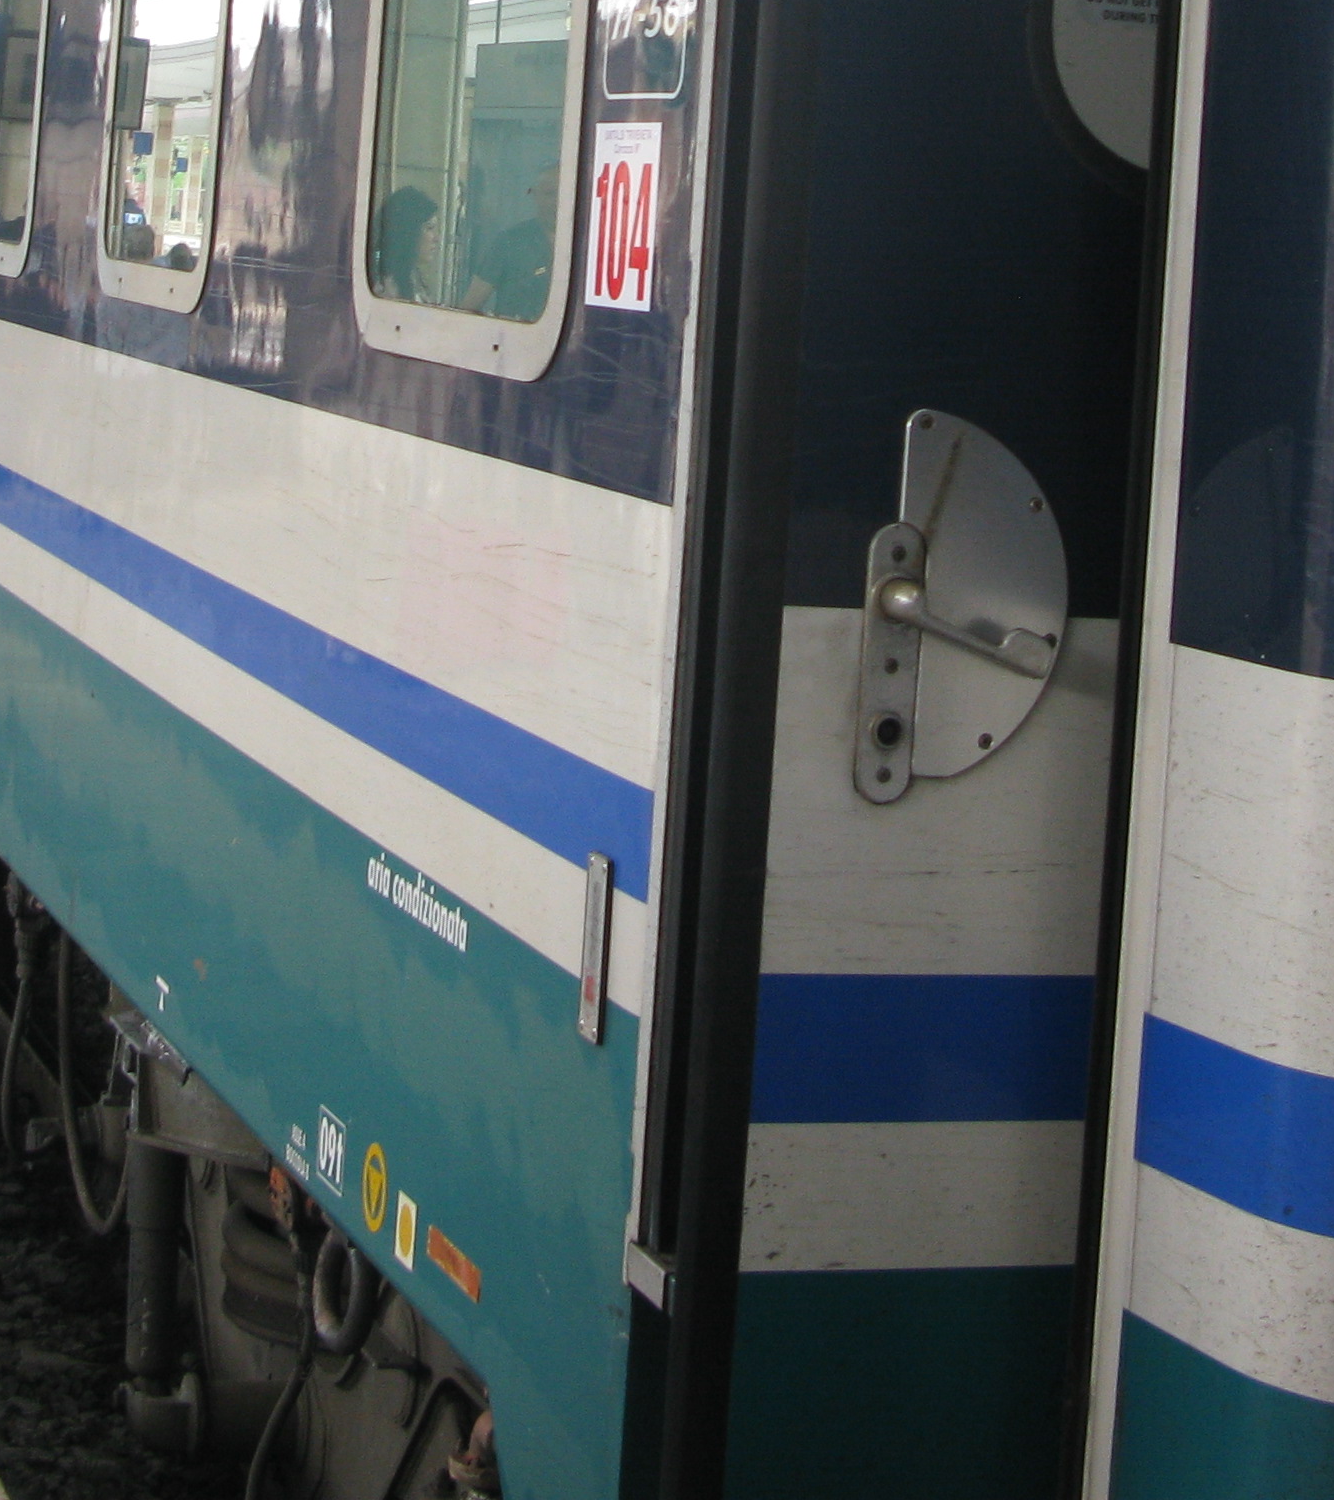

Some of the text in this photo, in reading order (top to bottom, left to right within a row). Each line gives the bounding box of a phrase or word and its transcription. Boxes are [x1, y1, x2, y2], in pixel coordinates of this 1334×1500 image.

[594, 160, 653, 302] 104
[367, 852, 468, 953] aria condizionata
